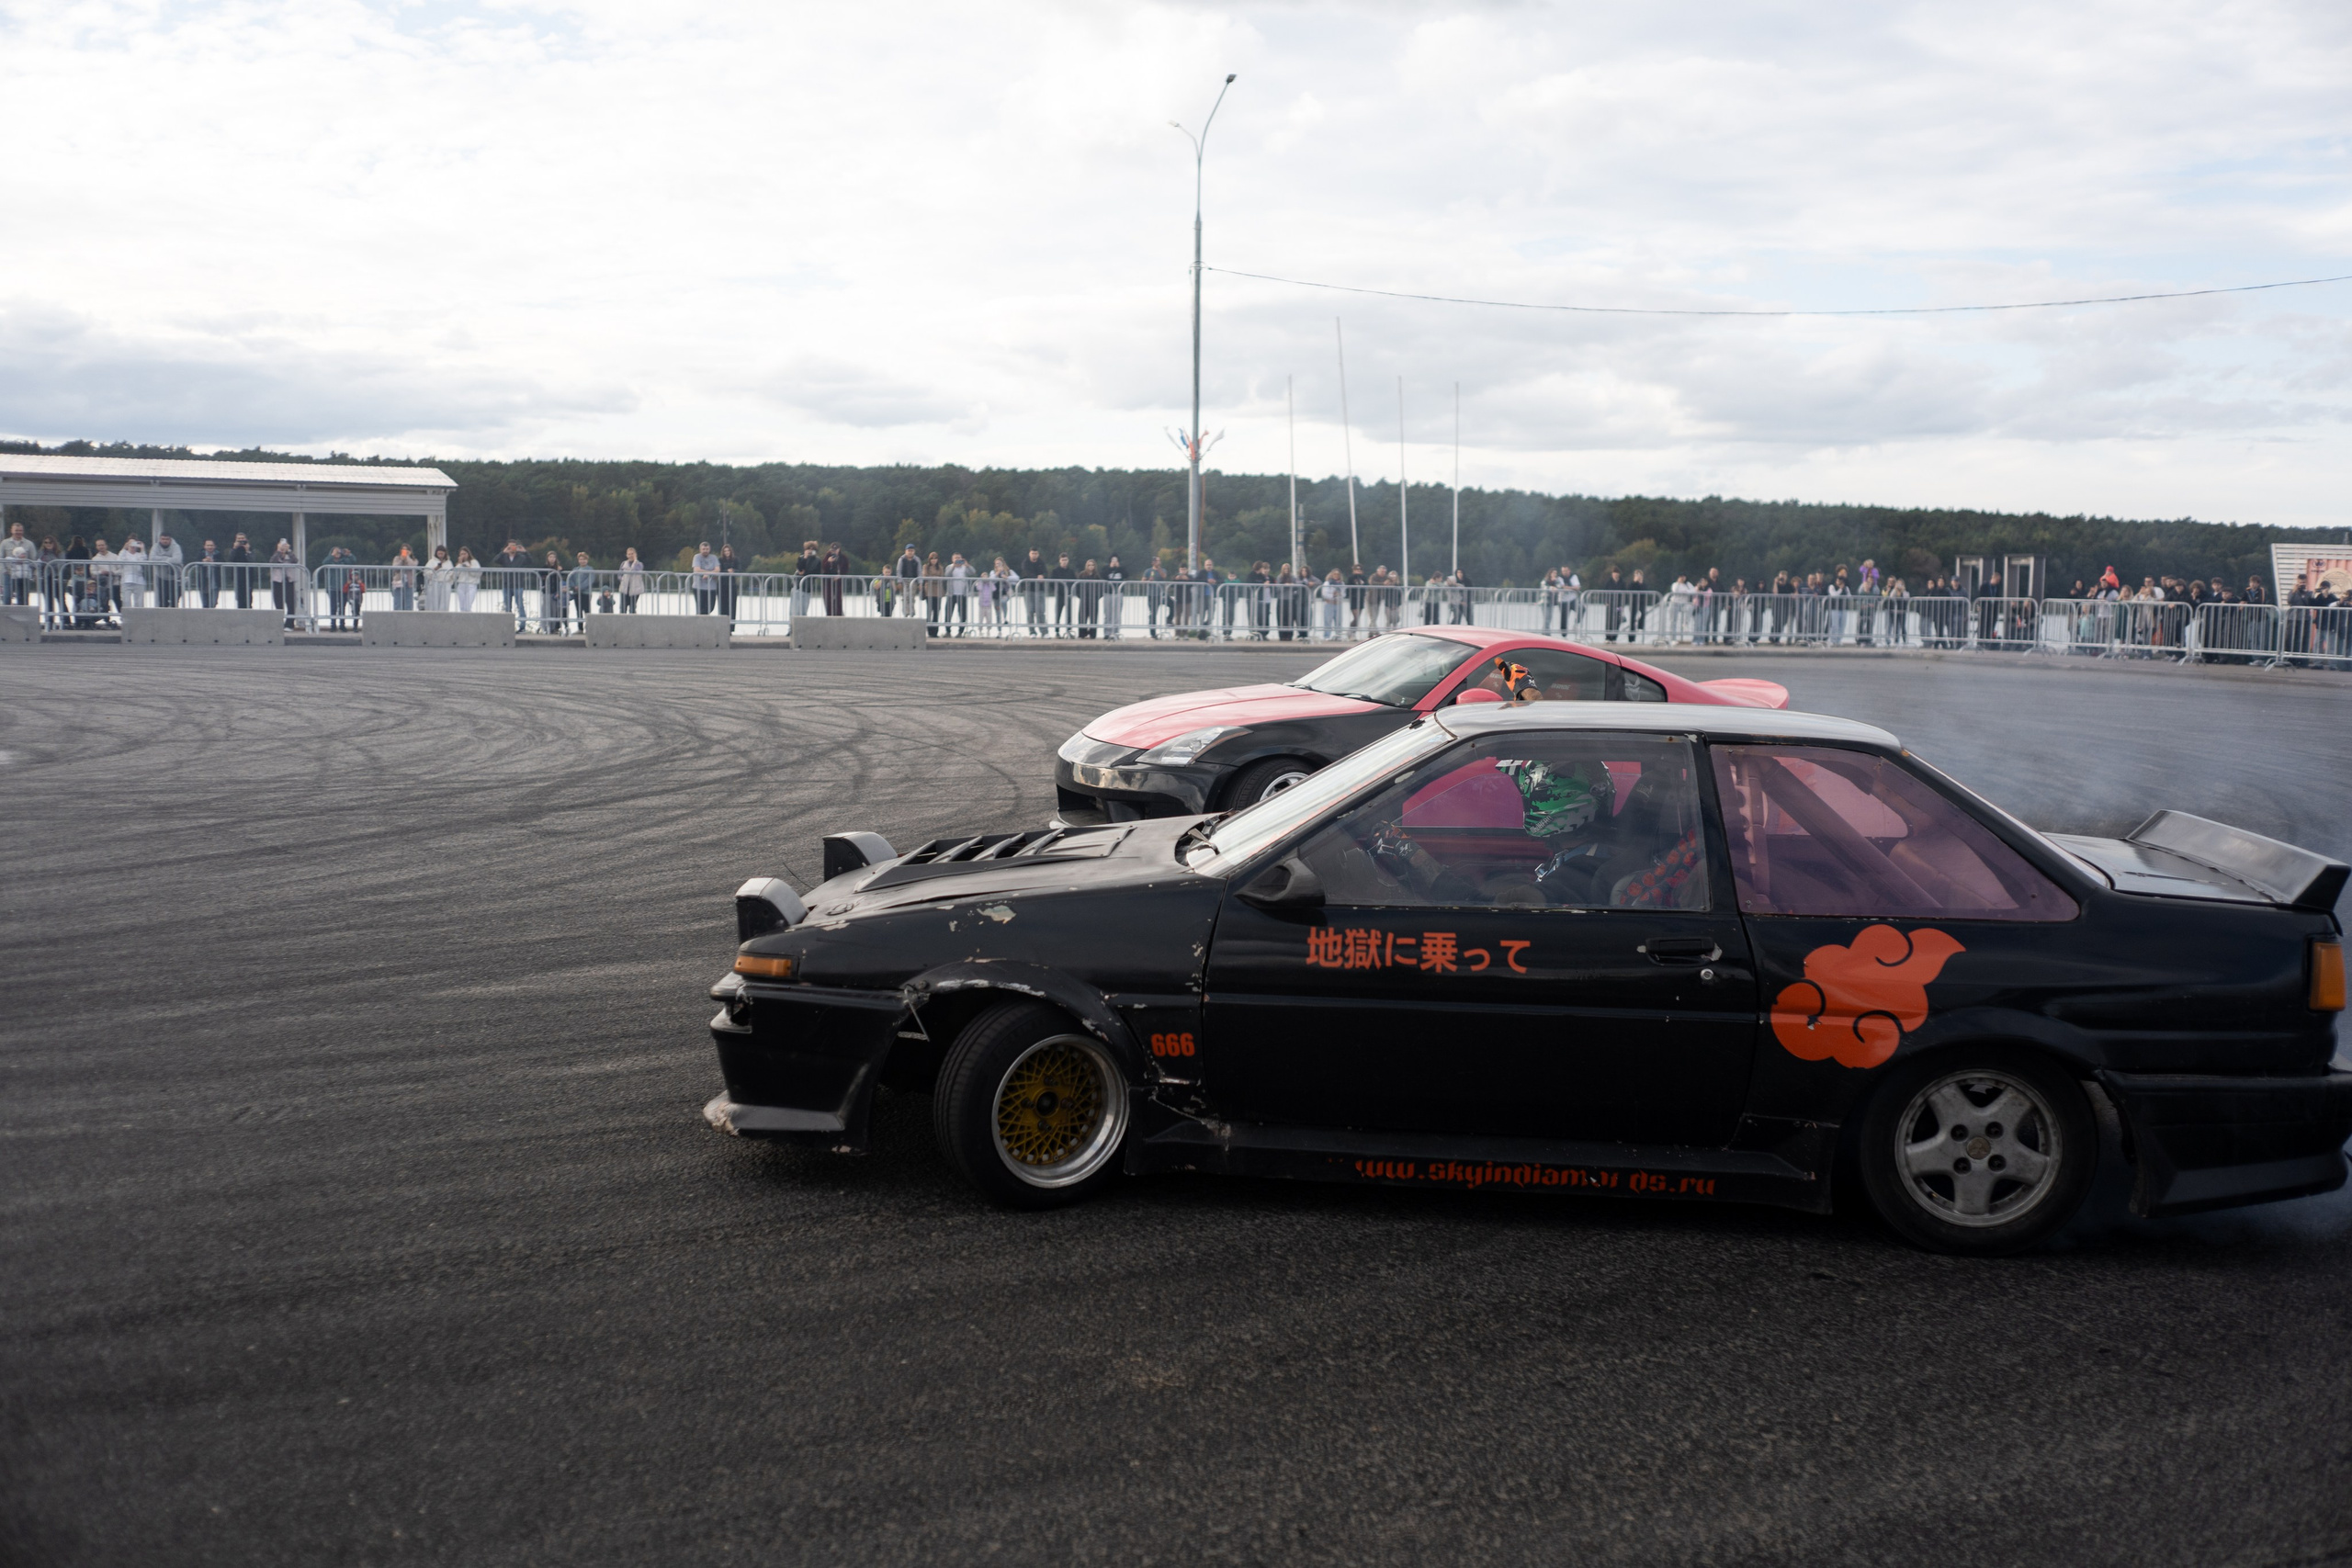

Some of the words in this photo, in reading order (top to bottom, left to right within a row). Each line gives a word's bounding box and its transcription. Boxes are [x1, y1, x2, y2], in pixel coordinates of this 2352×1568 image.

[1306, 926, 1532, 974] 地獄に乗って
[1150, 1032, 1195, 1057] 666
